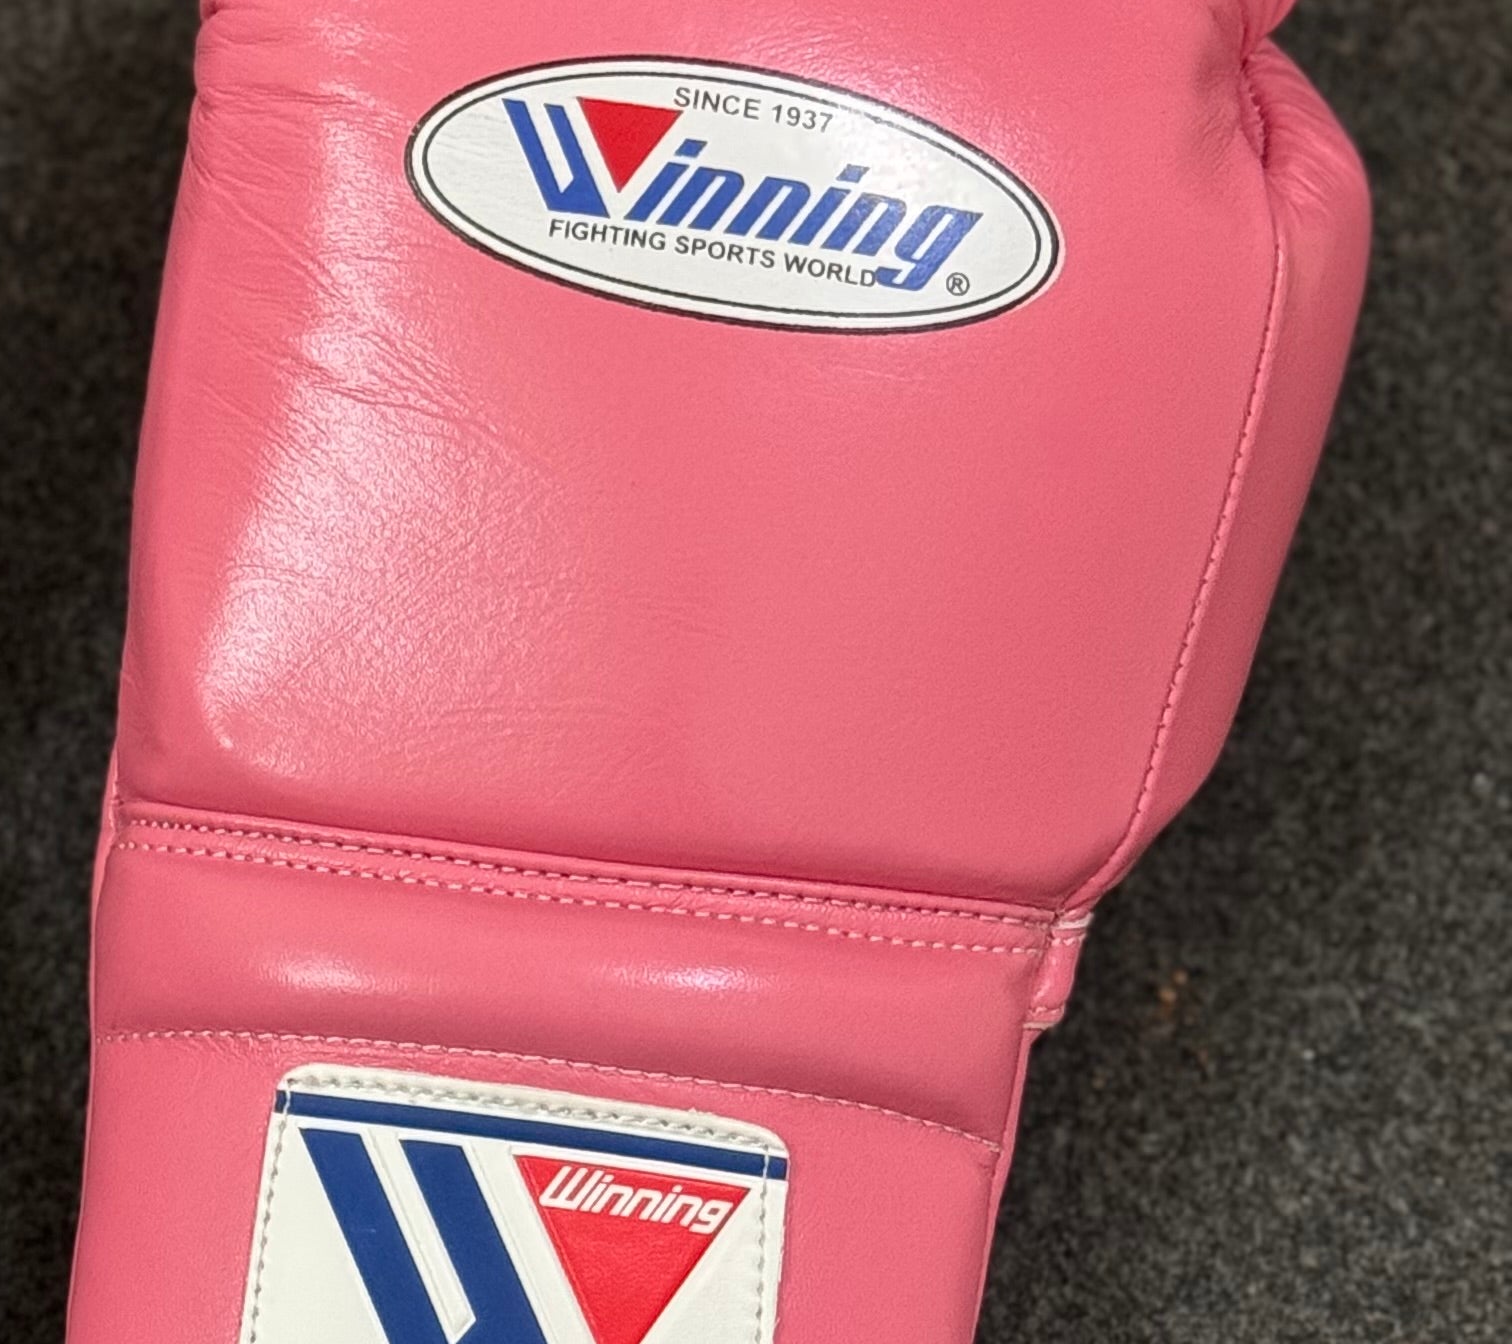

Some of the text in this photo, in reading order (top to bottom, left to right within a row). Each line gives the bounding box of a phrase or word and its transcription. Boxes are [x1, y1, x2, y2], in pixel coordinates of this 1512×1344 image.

[674, 86, 834, 134] SINCE 1937
[501, 96, 984, 292] Winning
[548, 217, 876, 288] FIGHTING SPORTS WORLD
[539, 1165, 734, 1235] Winning
